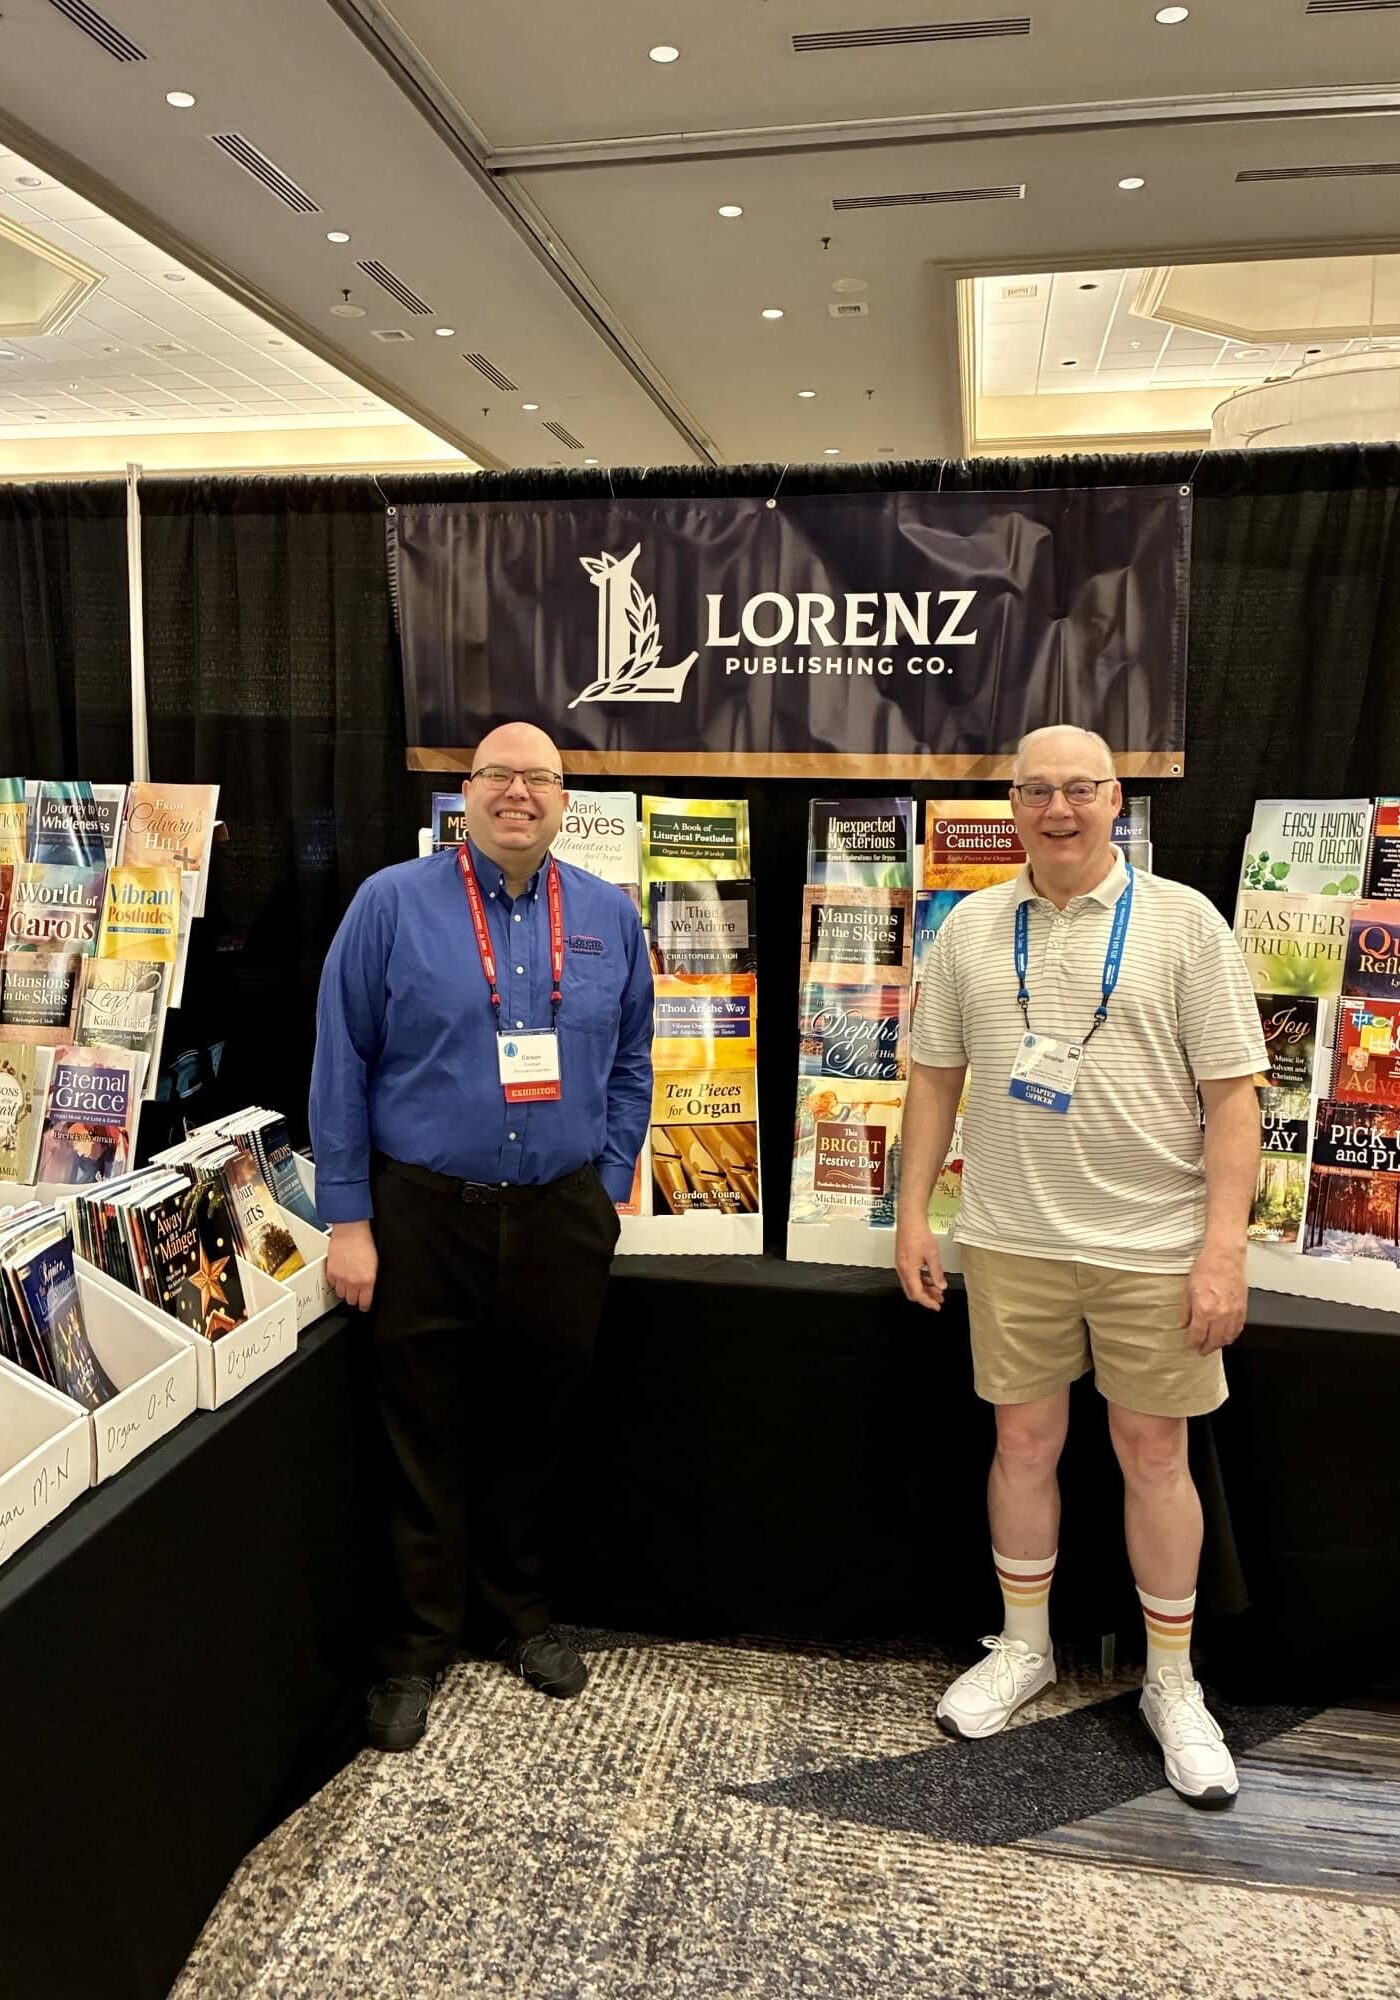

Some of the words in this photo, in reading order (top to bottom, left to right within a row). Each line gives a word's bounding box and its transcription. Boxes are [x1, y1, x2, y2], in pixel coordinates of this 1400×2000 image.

[705, 591, 979, 647] LORENZ
[725, 656, 894, 675] PUBLISHING
[907, 657, 954, 675] CO.
[46, 801, 86, 817] Journey
[565, 800, 603, 815] Mark
[42, 816, 98, 830] Wholeness
[128, 802, 202, 842] Calvary's
[560, 815, 625, 839] ayes
[673, 822, 679, 831] A
[681, 823, 701, 832] Book
[829, 816, 896, 836] Unexpected
[1115, 825, 1142, 836] River
[1282, 812, 1317, 837] EASY
[1320, 812, 1366, 838] HYMNS
[552, 838, 621, 852] Miniatures
[653, 831, 693, 842] Liturgical
[695, 834, 734, 843] Postludes
[828, 833, 896, 851] Mysterious
[946, 835, 1012, 849] Canticles
[1291, 841, 1314, 863] FOR
[1318, 839, 1363, 864] ORGAN
[16, 882, 83, 905] World
[86, 896, 98, 907] of
[111, 883, 174, 905] Vibrant
[107, 905, 173, 924] Postludes
[686, 906, 719, 918] Thee
[817, 908, 898, 925] Mansions
[10, 911, 94, 940] Carols
[671, 921, 691, 932] We
[696, 920, 735, 932] Adore
[1243, 909, 1346, 936] EASTER
[817, 927, 828, 937] in
[832, 927, 849, 937] the
[852, 926, 896, 942] Skies
[666, 952, 714, 960] CHRISTOPHER
[1240, 936, 1343, 961] TRIUMPH
[5, 973, 71, 989] Mansions
[4, 990, 12, 1000] in
[15, 990, 30, 1000] the
[32, 989, 68, 1005] Skies
[659, 1003, 686, 1013] Thou
[709, 1003, 723, 1013] the
[725, 1003, 746, 1015] Way
[94, 1016, 119, 1027] Kindly
[805, 1007, 900, 1050] Depths
[1263, 1007, 1310, 1044] Joy
[820, 1041, 898, 1078] Love
[870, 1050, 878, 1059] of
[880, 1050, 894, 1058] His
[1274, 1055, 1293, 1063] Music
[1295, 1056, 1305, 1064] for
[1271, 1064, 1293, 1073] Advent
[1295, 1065, 1306, 1073] and
[1271, 1073, 1303, 1081] Christmas
[57, 1070, 125, 1092] Eternal
[512, 1087, 557, 1097] EXHIBITOR
[666, 1084, 692, 1098] Ten
[698, 1083, 741, 1097] Pieces
[1025, 1084, 1057, 1099] CHAPTER
[1025, 1091, 1054, 1105] OFFICER
[55, 1087, 124, 1112] Grace
[667, 1104, 683, 1119] for
[687, 1100, 741, 1118] Organ
[1261, 1110, 1291, 1130] UP
[844, 1128, 858, 1137] This
[1330, 1125, 1387, 1150] PICK
[821, 1137, 881, 1154] BRIGHT
[819, 1153, 855, 1167] Festive
[858, 1156, 881, 1172] Day
[1336, 1149, 1368, 1163] and
[673, 1191, 708, 1200] Gordon
[711, 1190, 740, 1201] Young
[815, 1193, 847, 1205] Michael
[157, 1210, 182, 1239] Away
[160, 1228, 197, 1263] Manger
[228, 1343, 260, 1379] Organ
[107, 1421, 140, 1453] Organ
[33, 1447, 70, 1507] M-N
